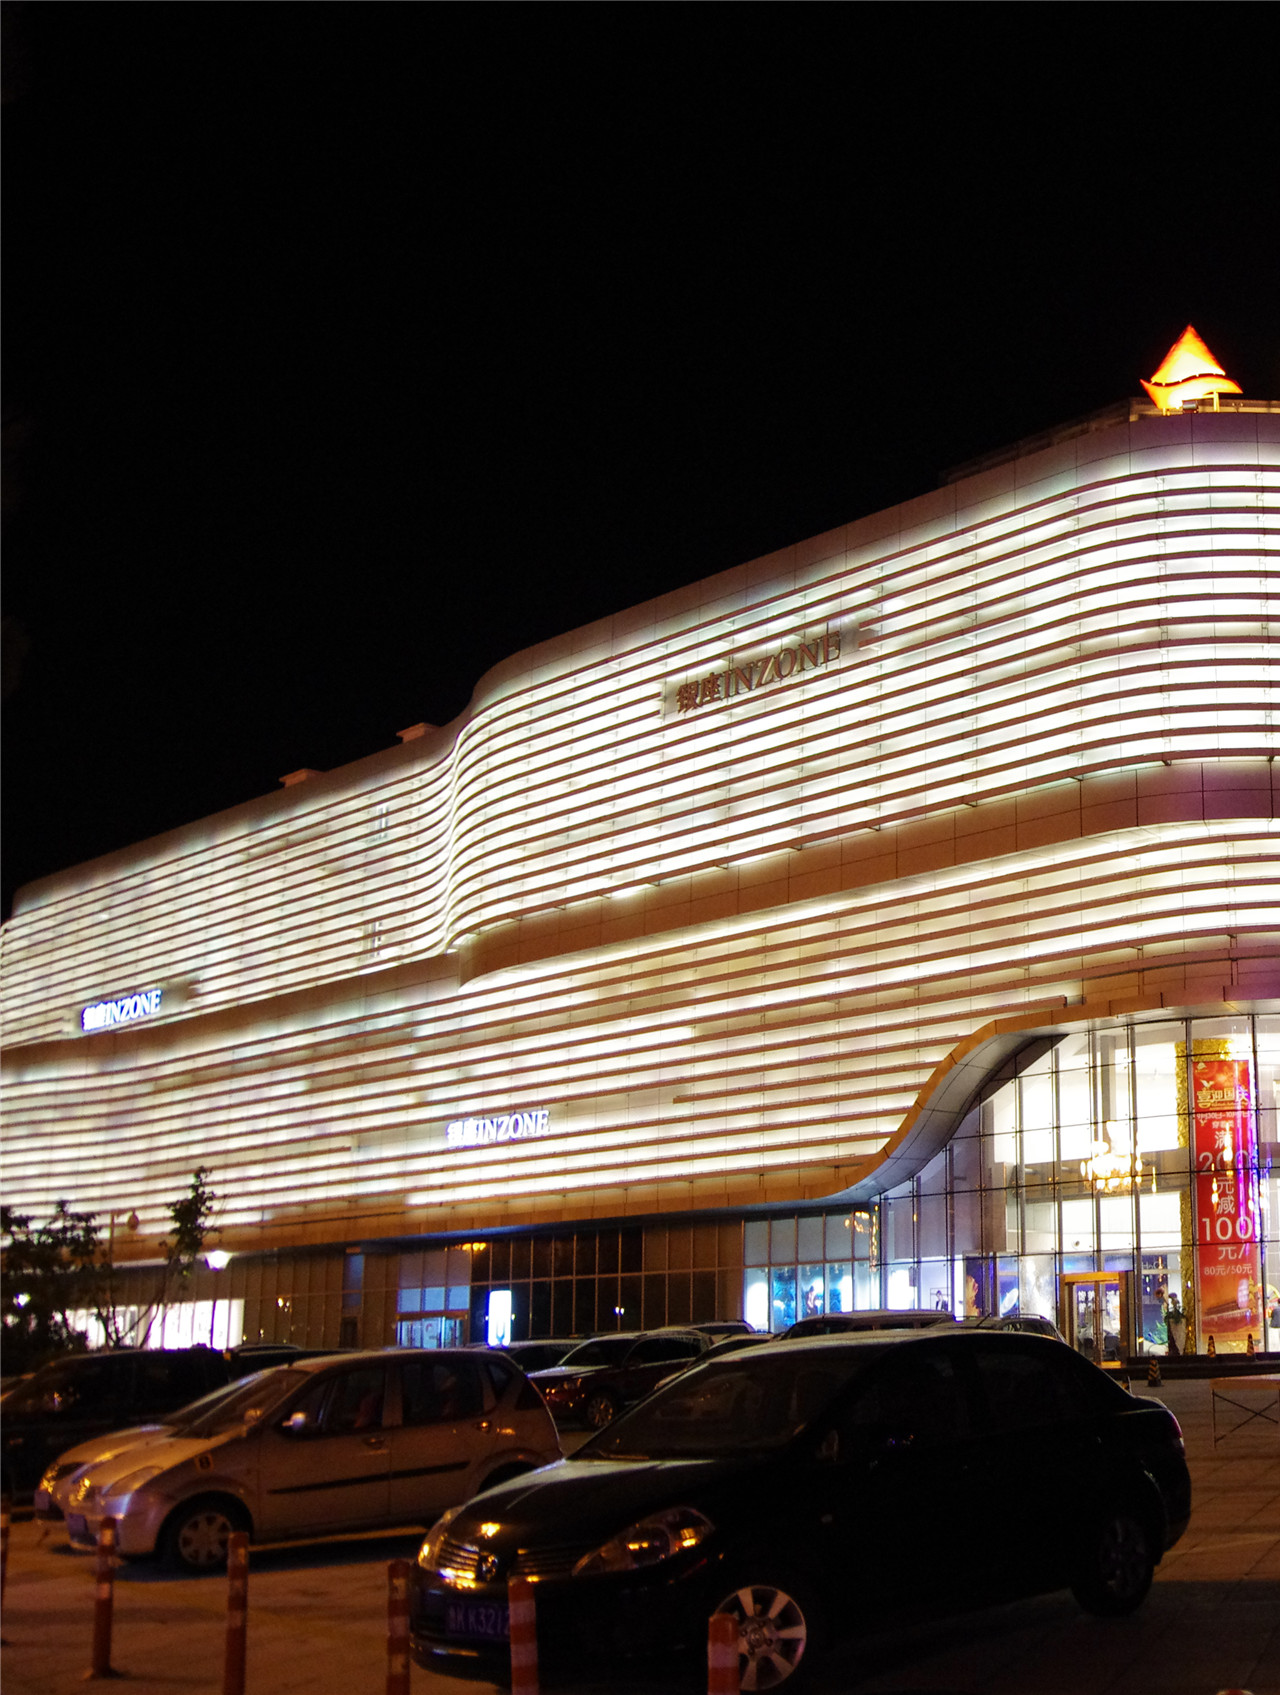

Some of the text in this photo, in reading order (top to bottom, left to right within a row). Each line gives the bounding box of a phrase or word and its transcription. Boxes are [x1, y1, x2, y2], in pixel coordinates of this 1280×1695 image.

[722, 630, 840, 699] INZONE
[477, 1110, 549, 1143] INZONE
[1217, 1177, 1235, 1195] 元
[1216, 1195, 1235, 1215] 减
[1202, 1216, 1254, 1241] 100
[1204, 1264, 1253, 1277] 80元/50元
